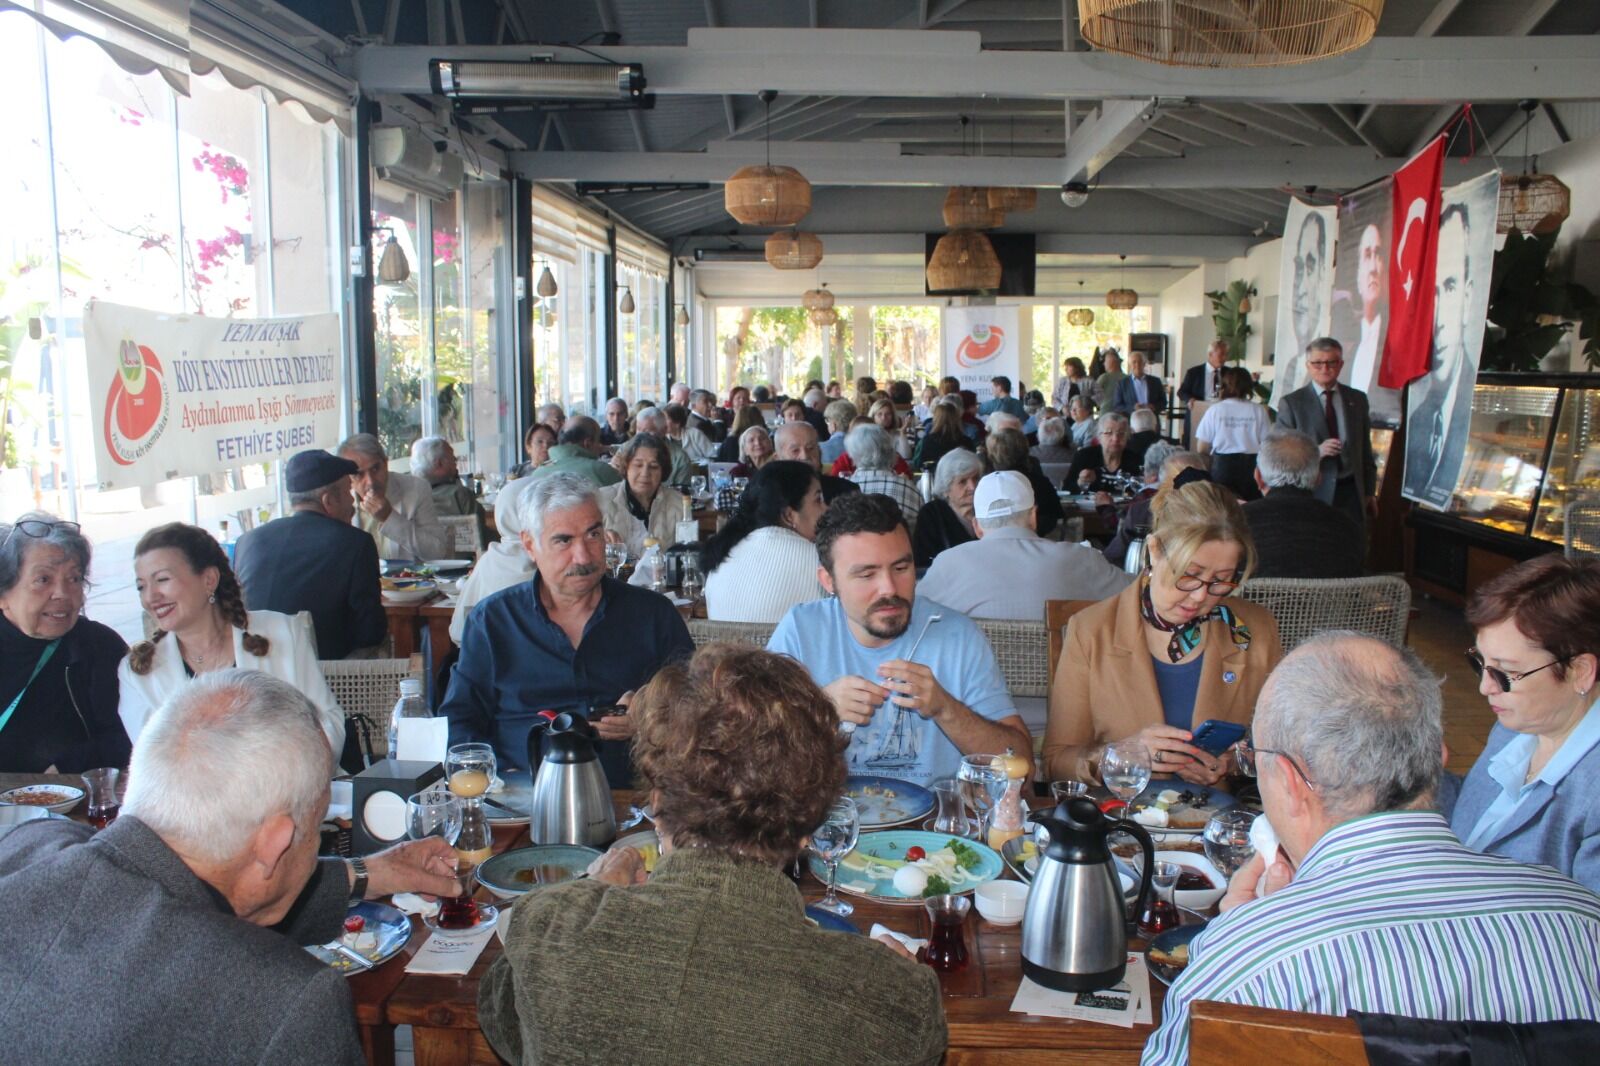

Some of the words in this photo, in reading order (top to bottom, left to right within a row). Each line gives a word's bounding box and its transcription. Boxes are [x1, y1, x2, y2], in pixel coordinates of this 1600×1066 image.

[257, 320, 304, 347] KUŞAK
[173, 349, 202, 392] KÖY
[202, 348, 295, 391] ENSTİTÜLÜLER
[292, 347, 335, 384] DERNEĞİ
[181, 400, 257, 433] Aydınlanma
[257, 397, 282, 424] Işığı
[285, 389, 336, 416] Sönmeyecek
[216, 429, 273, 462] FETHİYE
[276, 420, 316, 455] ŞUBESİ
